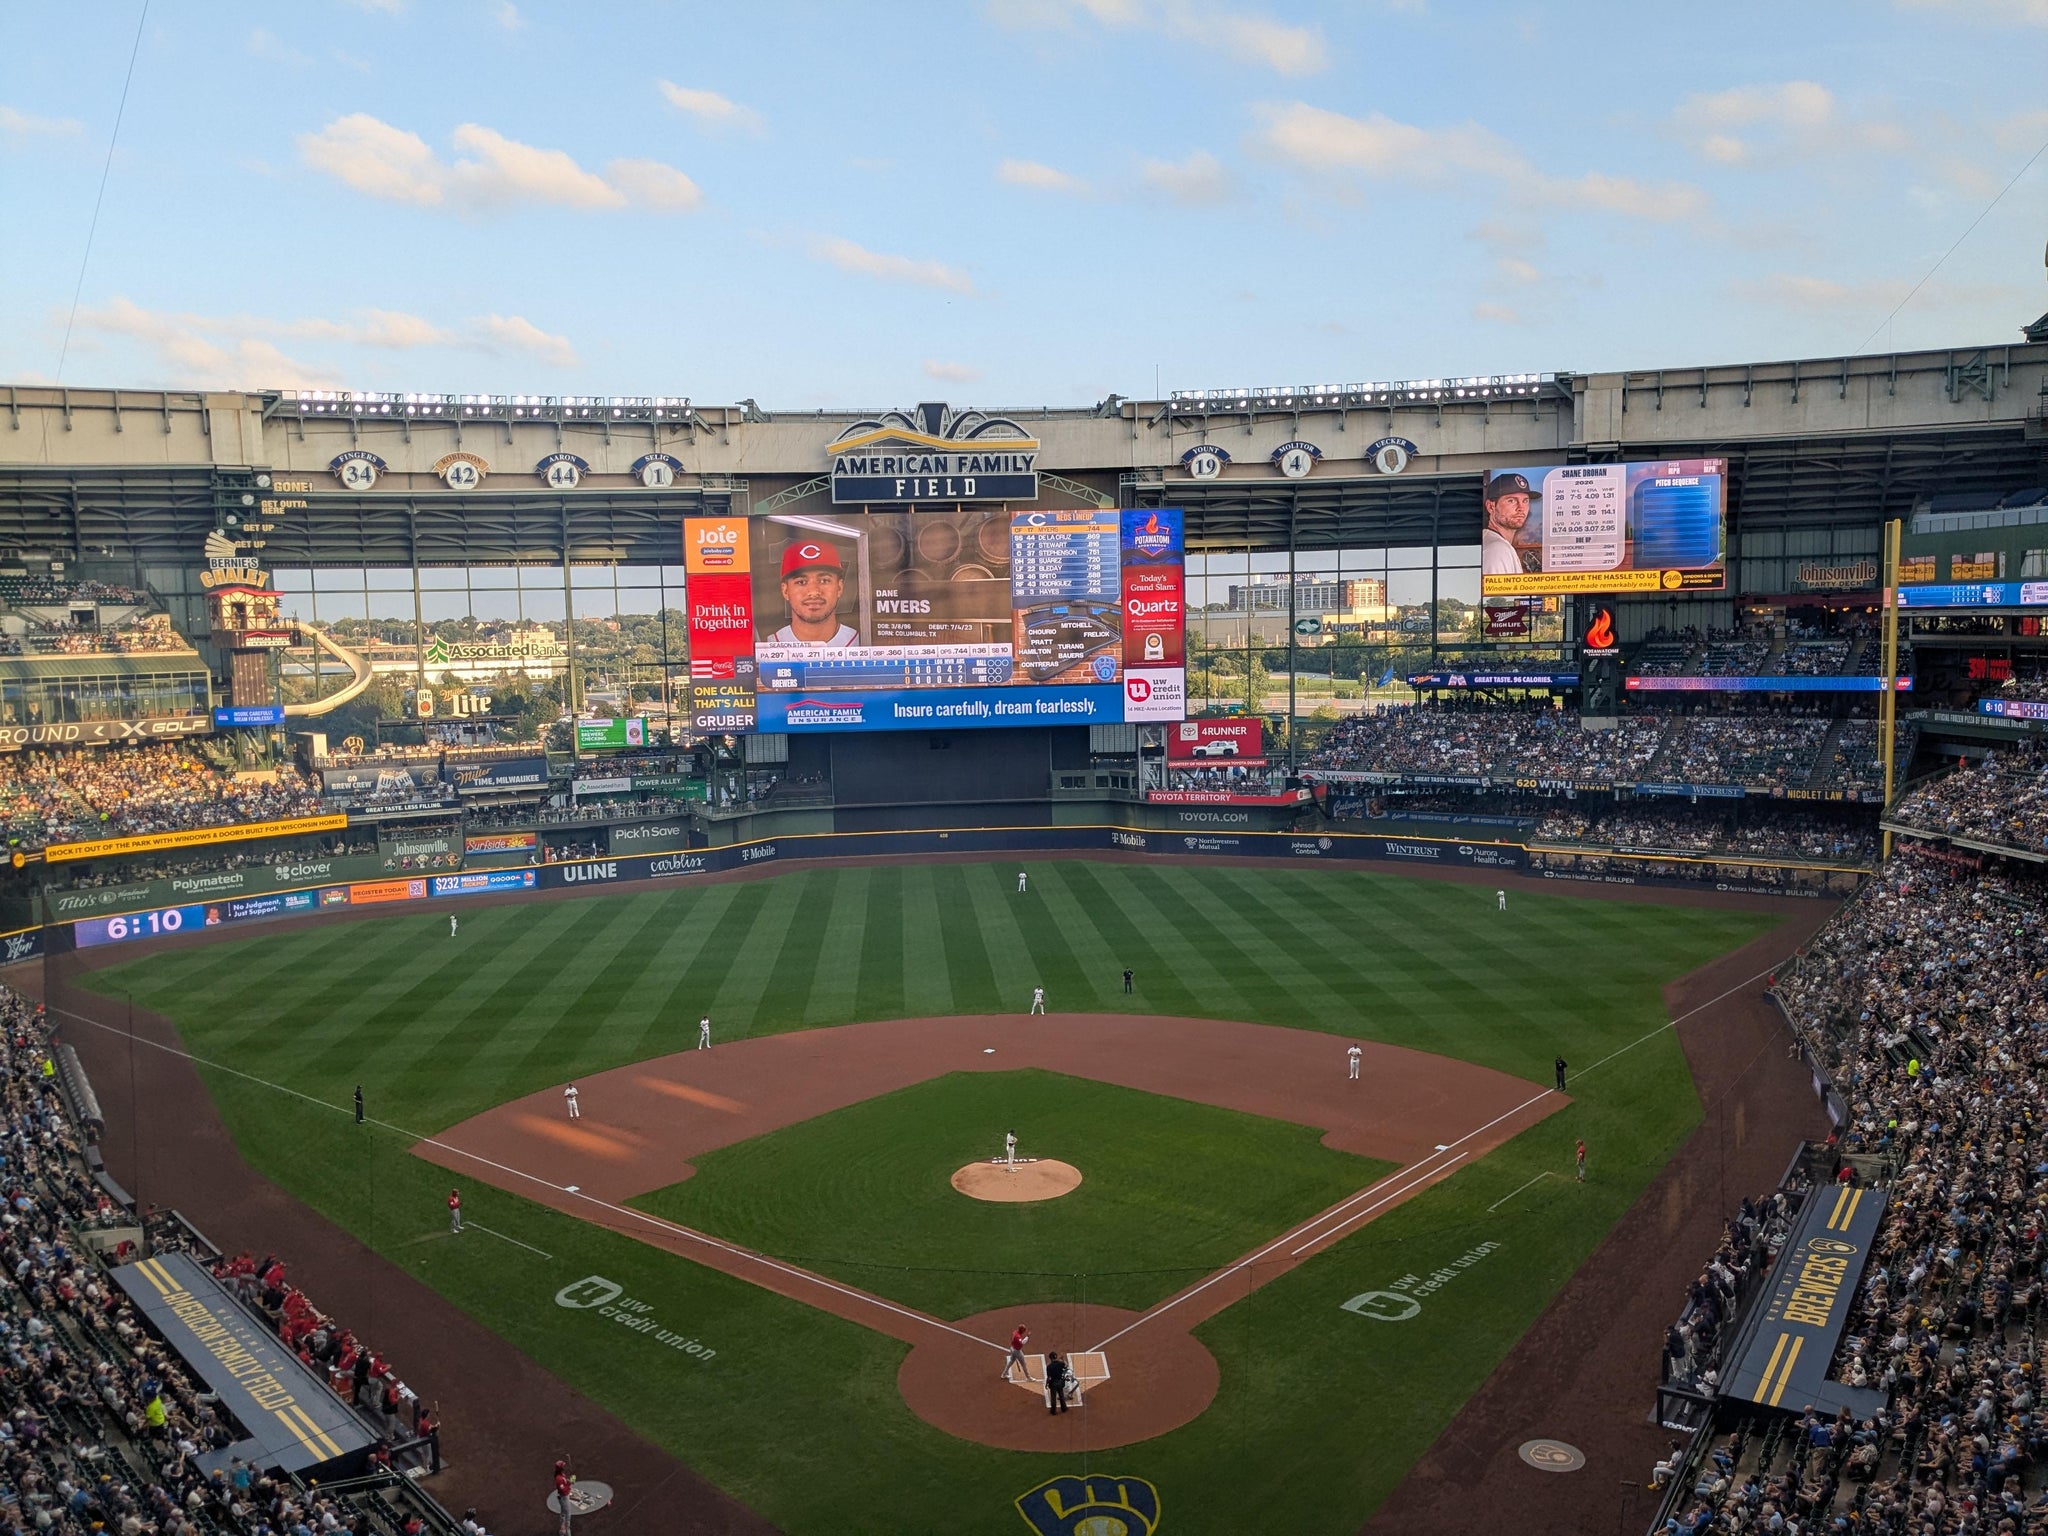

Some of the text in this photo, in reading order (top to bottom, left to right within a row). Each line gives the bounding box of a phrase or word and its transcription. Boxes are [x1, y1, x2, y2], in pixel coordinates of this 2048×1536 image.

[1278, 441, 1316, 454] MOLITOR
[1376, 438, 1407, 448] UECKER
[339, 452, 378, 463] FINGERS
[549, 454, 576, 462] AARON
[644, 454, 669, 462] SELIG
[834, 455, 1035, 475] AMERICAN FAMILY
[1195, 459, 1216, 475] 19
[346, 466, 372, 483] 34
[450, 467, 476, 484] 42
[551, 467, 576, 484] 44
[1562, 468, 1607, 478] SHANE DROHAN
[274, 482, 313, 492] GONE!
[895, 478, 976, 496] FIELD
[1656, 478, 1699, 487] PITCH SEQUENCE
[261, 500, 307, 508] GET OUTTA
[697, 525, 738, 544] Joie
[1134, 535, 1170, 545] POTAWATOMI
[210, 558, 258, 568] BERNIE'S
[200, 568, 269, 587] CHALET
[1796, 562, 1877, 582] Johnsonville
[1140, 575, 1167, 583] Today's
[1485, 584, 1512, 592] Window
[1537, 583, 1578, 592] replacement
[1600, 582, 1637, 590] remarkably
[696, 604, 745, 617] Drink in
[876, 600, 931, 614] MYERS
[1128, 599, 1178, 616] Quartz
[692, 616, 750, 632] Together
[1325, 619, 1430, 633] Aurora Health Care
[451, 643, 562, 658] Associated Bank
[694, 686, 754, 696] ONE CALL...
[694, 698, 755, 708] THAT'S ALL!
[894, 698, 1097, 718] Insure carefully, dream fearlessly.
[788, 708, 862, 717] AMERICAN FAMILY
[152, 720, 207, 732] GOLF
[697, 715, 754, 726] GRUBER
[1202, 727, 1247, 735] 4RUNNER
[331, 782, 351, 790] BREW
[474, 775, 539, 786] TIME, MILWAUKEE
[1516, 779, 1572, 789] 620 WTMJ
[1692, 786, 1739, 796] WINTRUST
[1787, 790, 1843, 800] NICOLET LAW
[1179, 812, 1248, 822] TOYOTA.COM
[175, 833, 211, 843] WINDOWS
[219, 830, 244, 838] DOORS
[281, 822, 318, 830] WISCONSIN
[615, 826, 680, 839] Pick Save
[393, 840, 448, 857] Johnsonville
[466, 840, 506, 851] Surfside
[1386, 842, 1439, 856] WINTRUST
[1474, 849, 1498, 857] Aurora
[651, 854, 705, 873] carbliss
[1474, 855, 1516, 865] Health Care
[291, 862, 331, 876] clover
[564, 862, 617, 882] ULINE
[173, 874, 243, 890] Polymatech
[436, 877, 459, 891] $232
[1605, 876, 1635, 884] BULLPEN
[353, 888, 383, 896] REGISTER
[1785, 889, 1819, 897] BULLPEN
[58, 894, 96, 910] Tito's
[245, 899, 281, 909] Judgment,
[248, 907, 278, 916] Support.
[108, 910, 182, 939] 6:10
[1413, 1240, 1501, 1296] credit union
[1783, 1254, 1848, 1327] BREWERS
[599, 1306, 717, 1360] credit union
[162, 1292, 295, 1410] AMERICAN FAMILY FIELD
